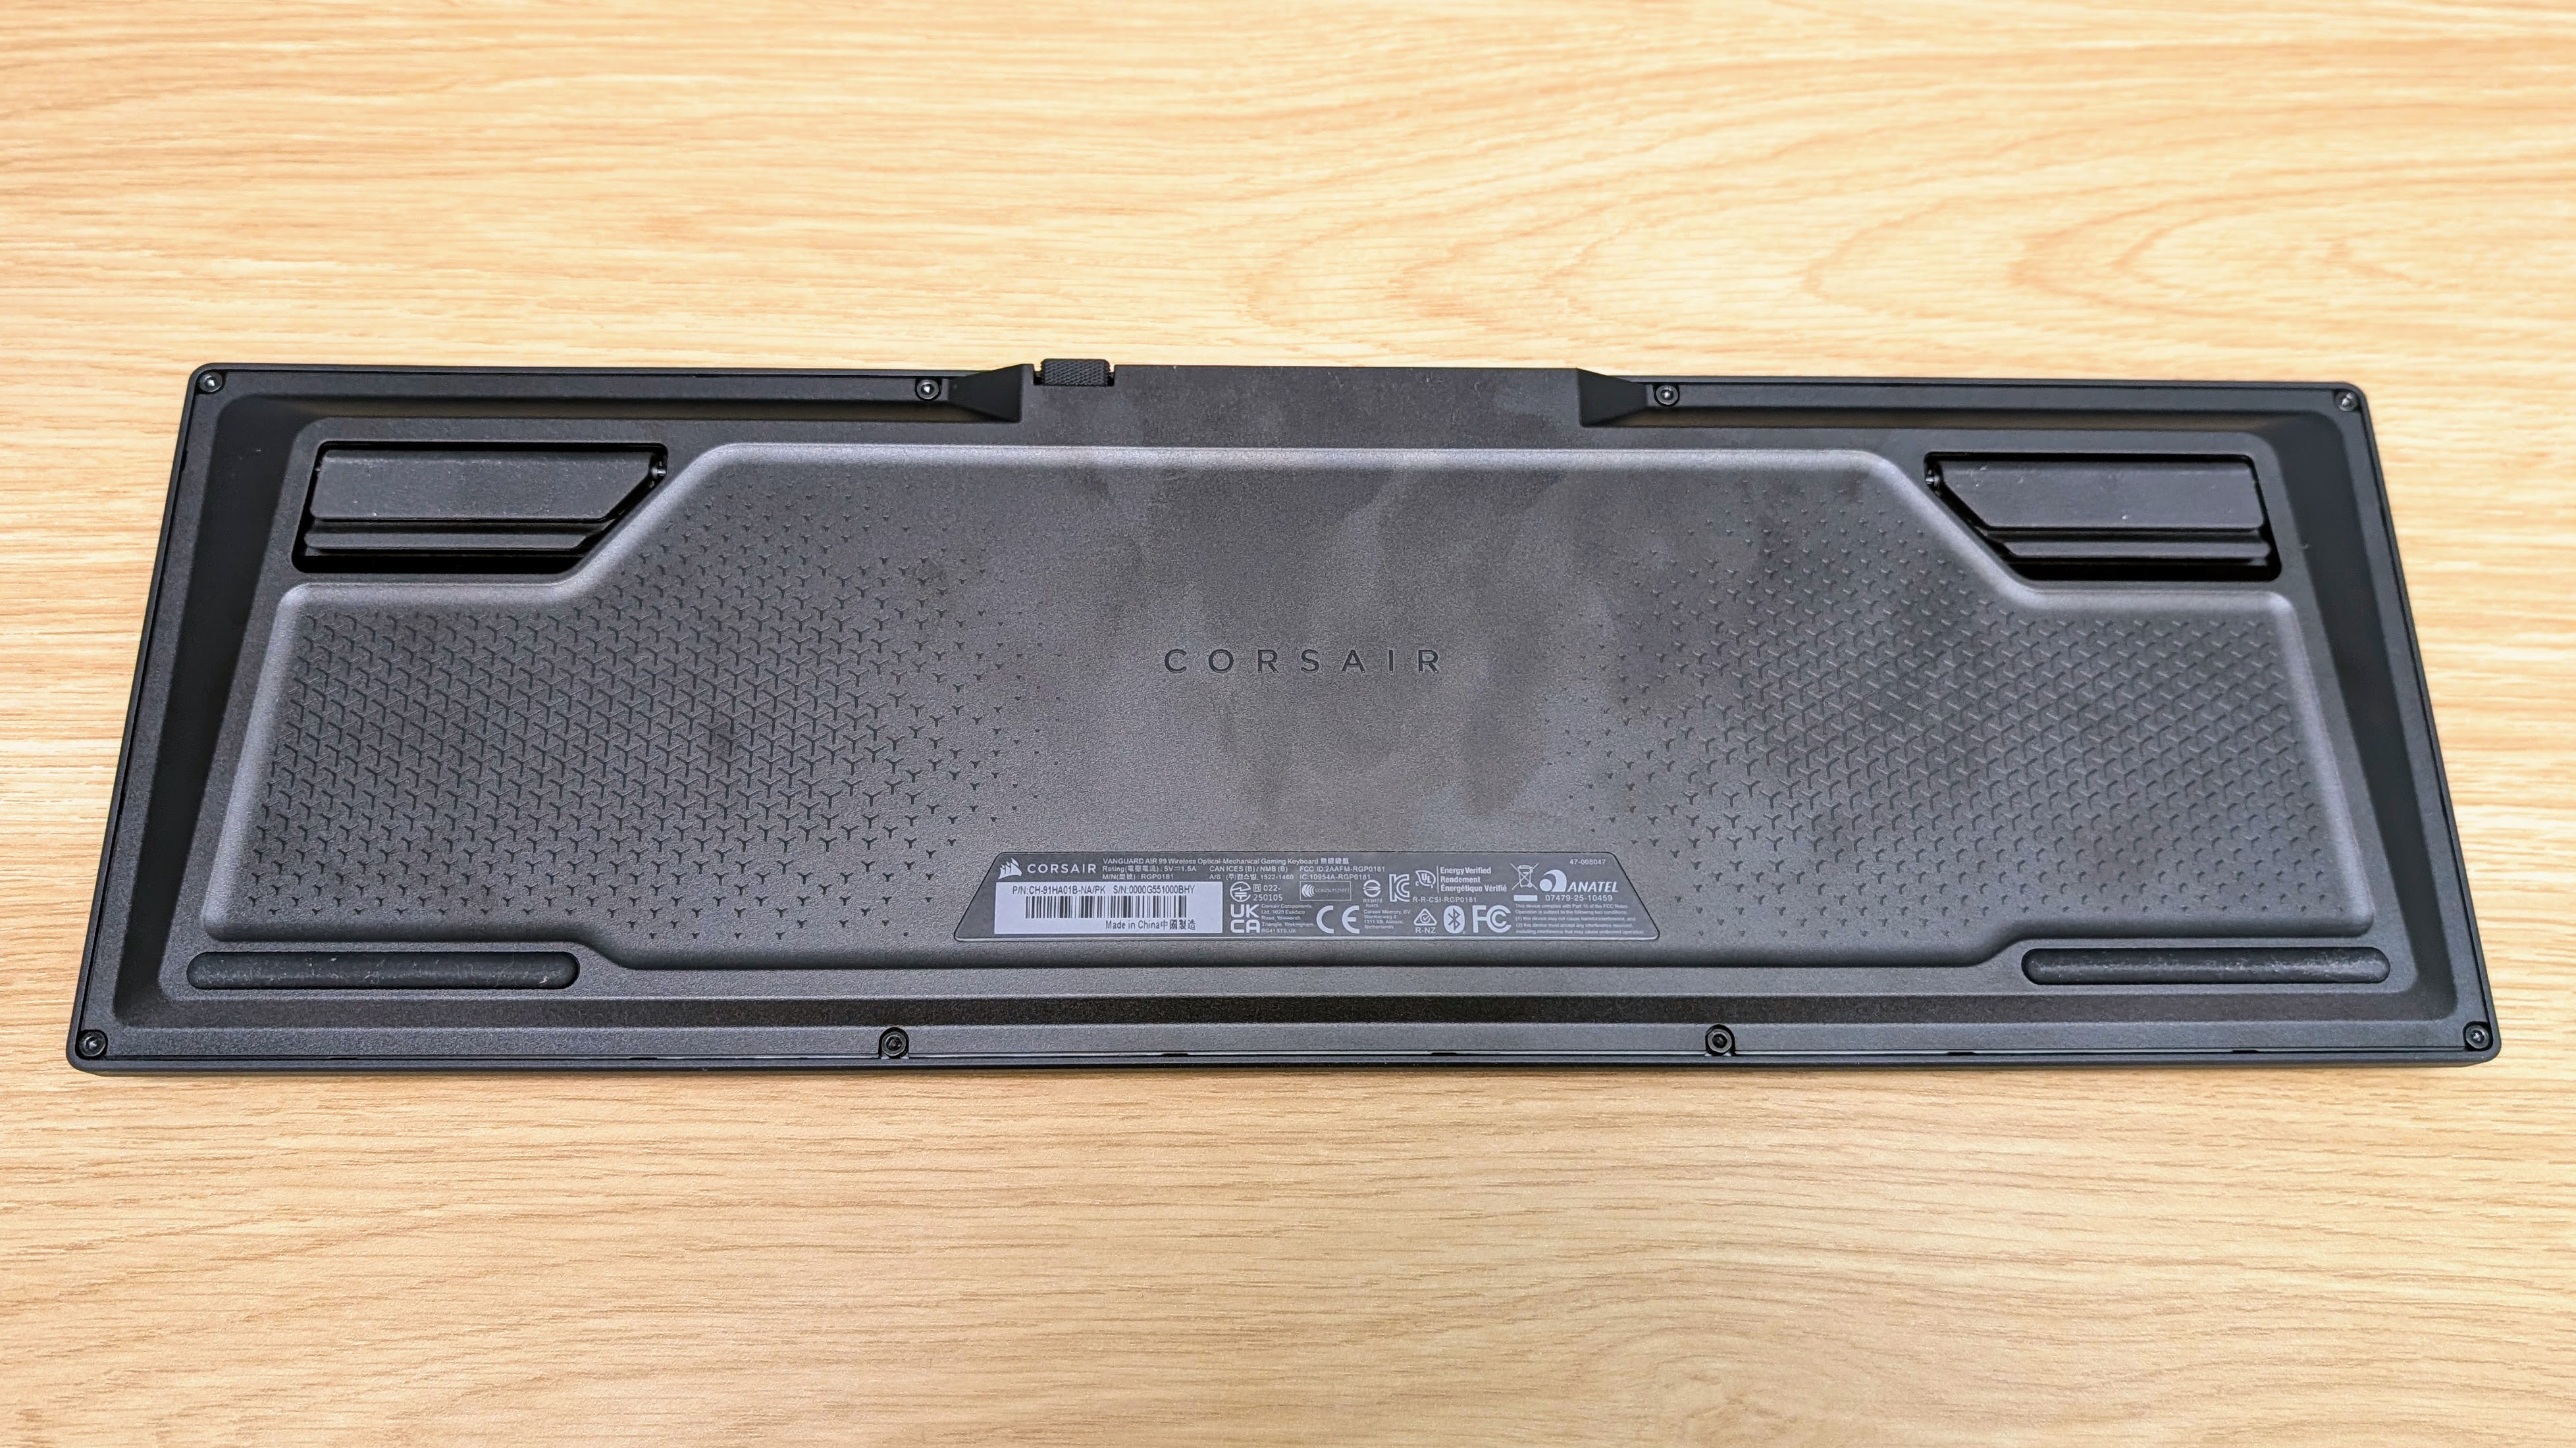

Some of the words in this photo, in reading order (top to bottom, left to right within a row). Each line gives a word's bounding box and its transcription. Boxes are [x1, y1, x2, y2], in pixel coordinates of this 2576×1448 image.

[1164, 648, 1440, 674] CORSAIR
[1027, 863, 1097, 874] CORSAIR
[1440, 867, 1464, 875] Energy
[1421, 873, 1432, 883] UL
[1012, 885, 1106, 895] P/N:CH-91HA01B-NA/PK
[1113, 885, 1196, 894] S/N:0000G551000BHY
[1440, 883, 1483, 893] Énergétique
[1484, 883, 1507, 892] Vérifié
[1567, 881, 1619, 892] ANATEL
[1230, 904, 1260, 918] UK
[1105, 919, 1126, 929] Made
[1128, 919, 1136, 929] in
[1316, 904, 1361, 935] CE
[1230, 919, 1261, 933] CA
